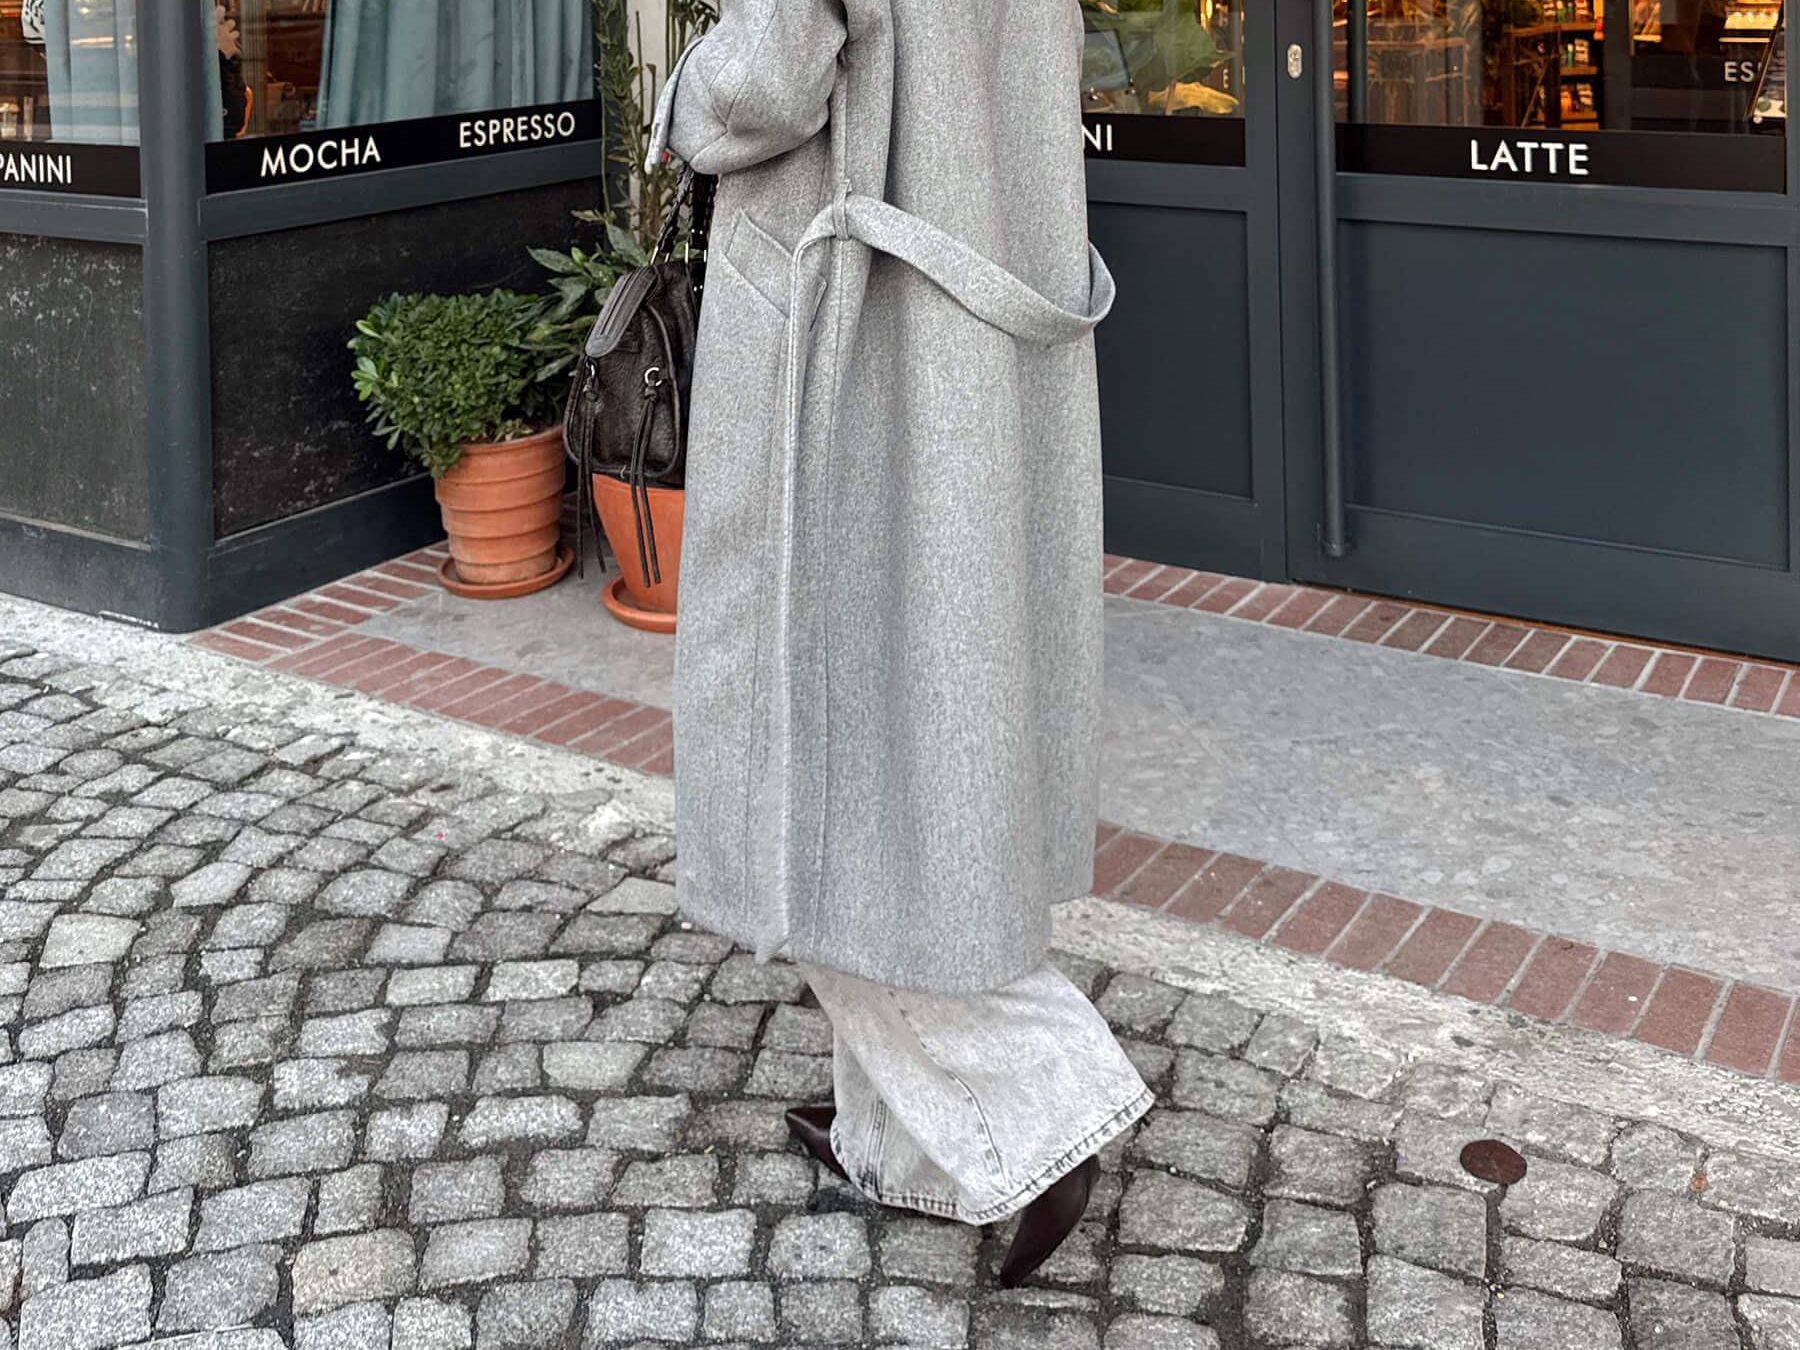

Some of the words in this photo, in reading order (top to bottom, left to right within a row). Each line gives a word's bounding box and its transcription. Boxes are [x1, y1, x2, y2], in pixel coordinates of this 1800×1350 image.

[1724, 61, 1762, 82] ES
[459, 111, 576, 148] ESPRESSO
[260, 136, 381, 177] MOCHA
[1470, 139, 1590, 176] LATTE
